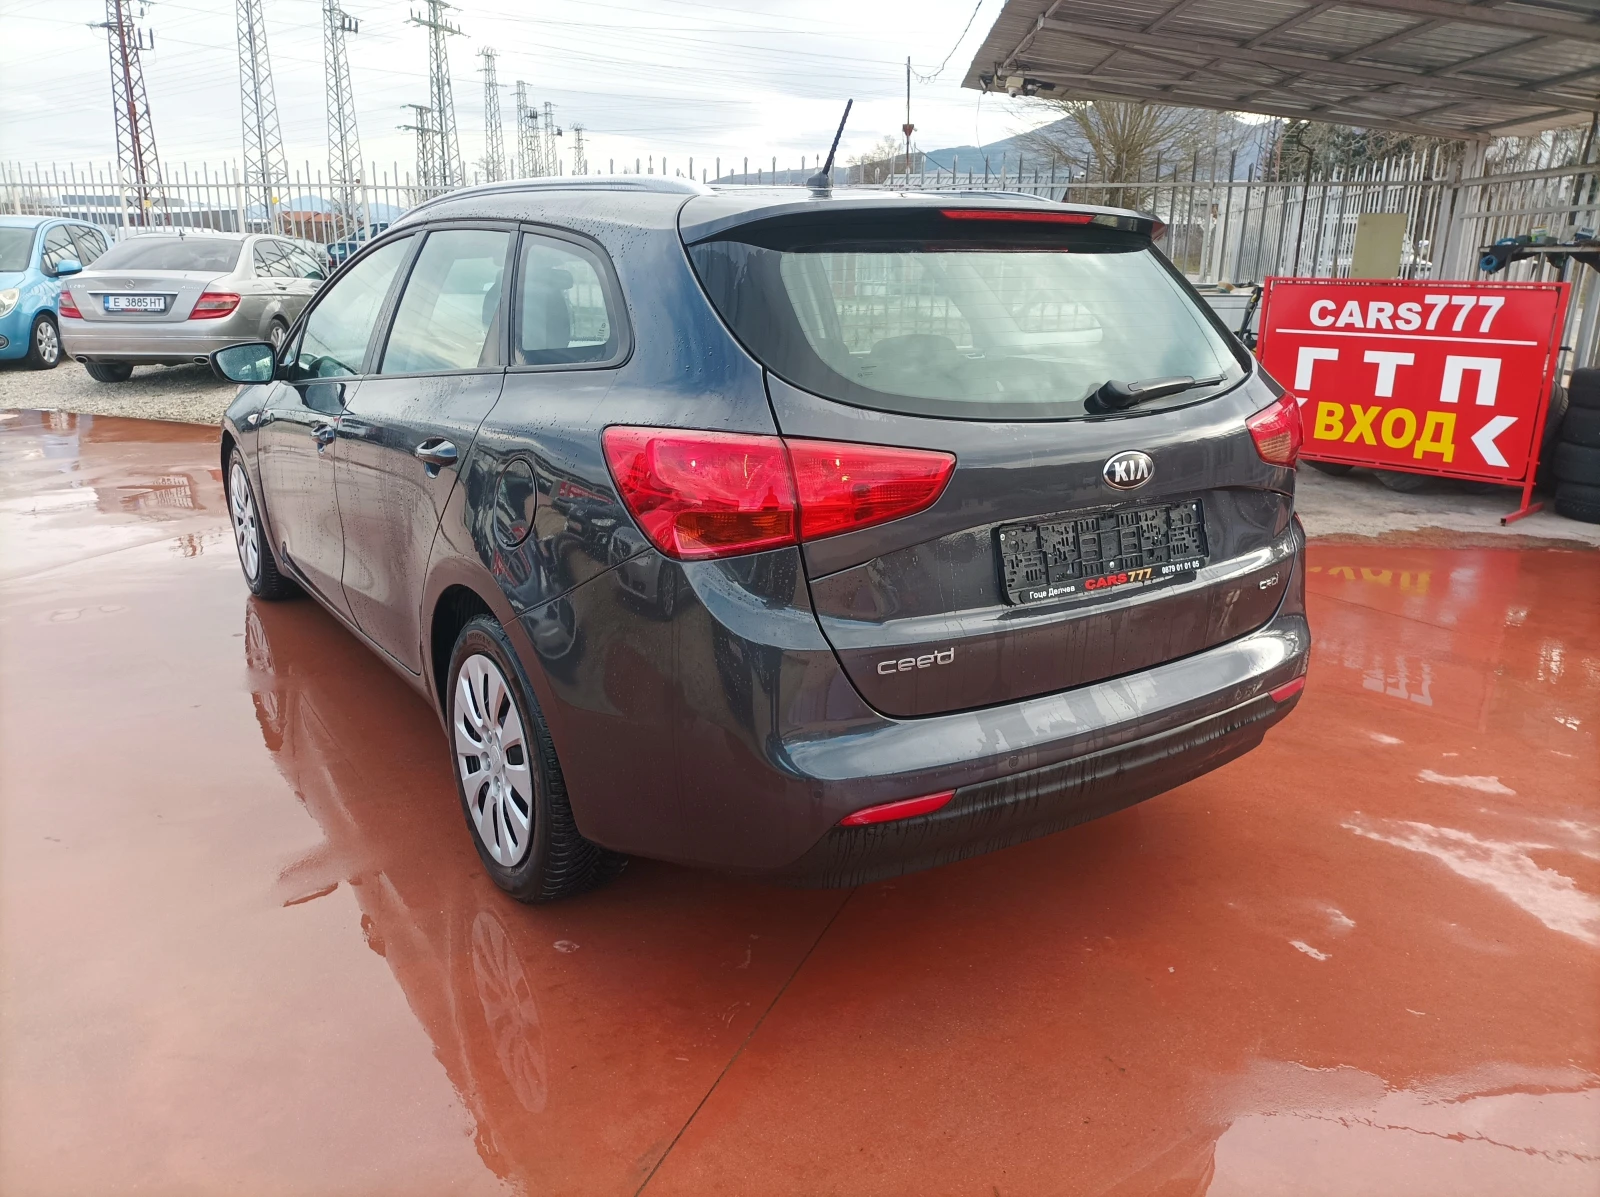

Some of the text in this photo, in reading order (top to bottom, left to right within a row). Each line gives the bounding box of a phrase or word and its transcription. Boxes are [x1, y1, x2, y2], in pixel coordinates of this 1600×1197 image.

[113, 297, 120, 307] E
[125, 297, 148, 308] 3885
[1309, 294, 1505, 333] CARS777
[1313, 400, 1457, 463] ВХОД
[1113, 458, 1149, 483] KIA
[1029, 591, 1047, 600] Гоце
